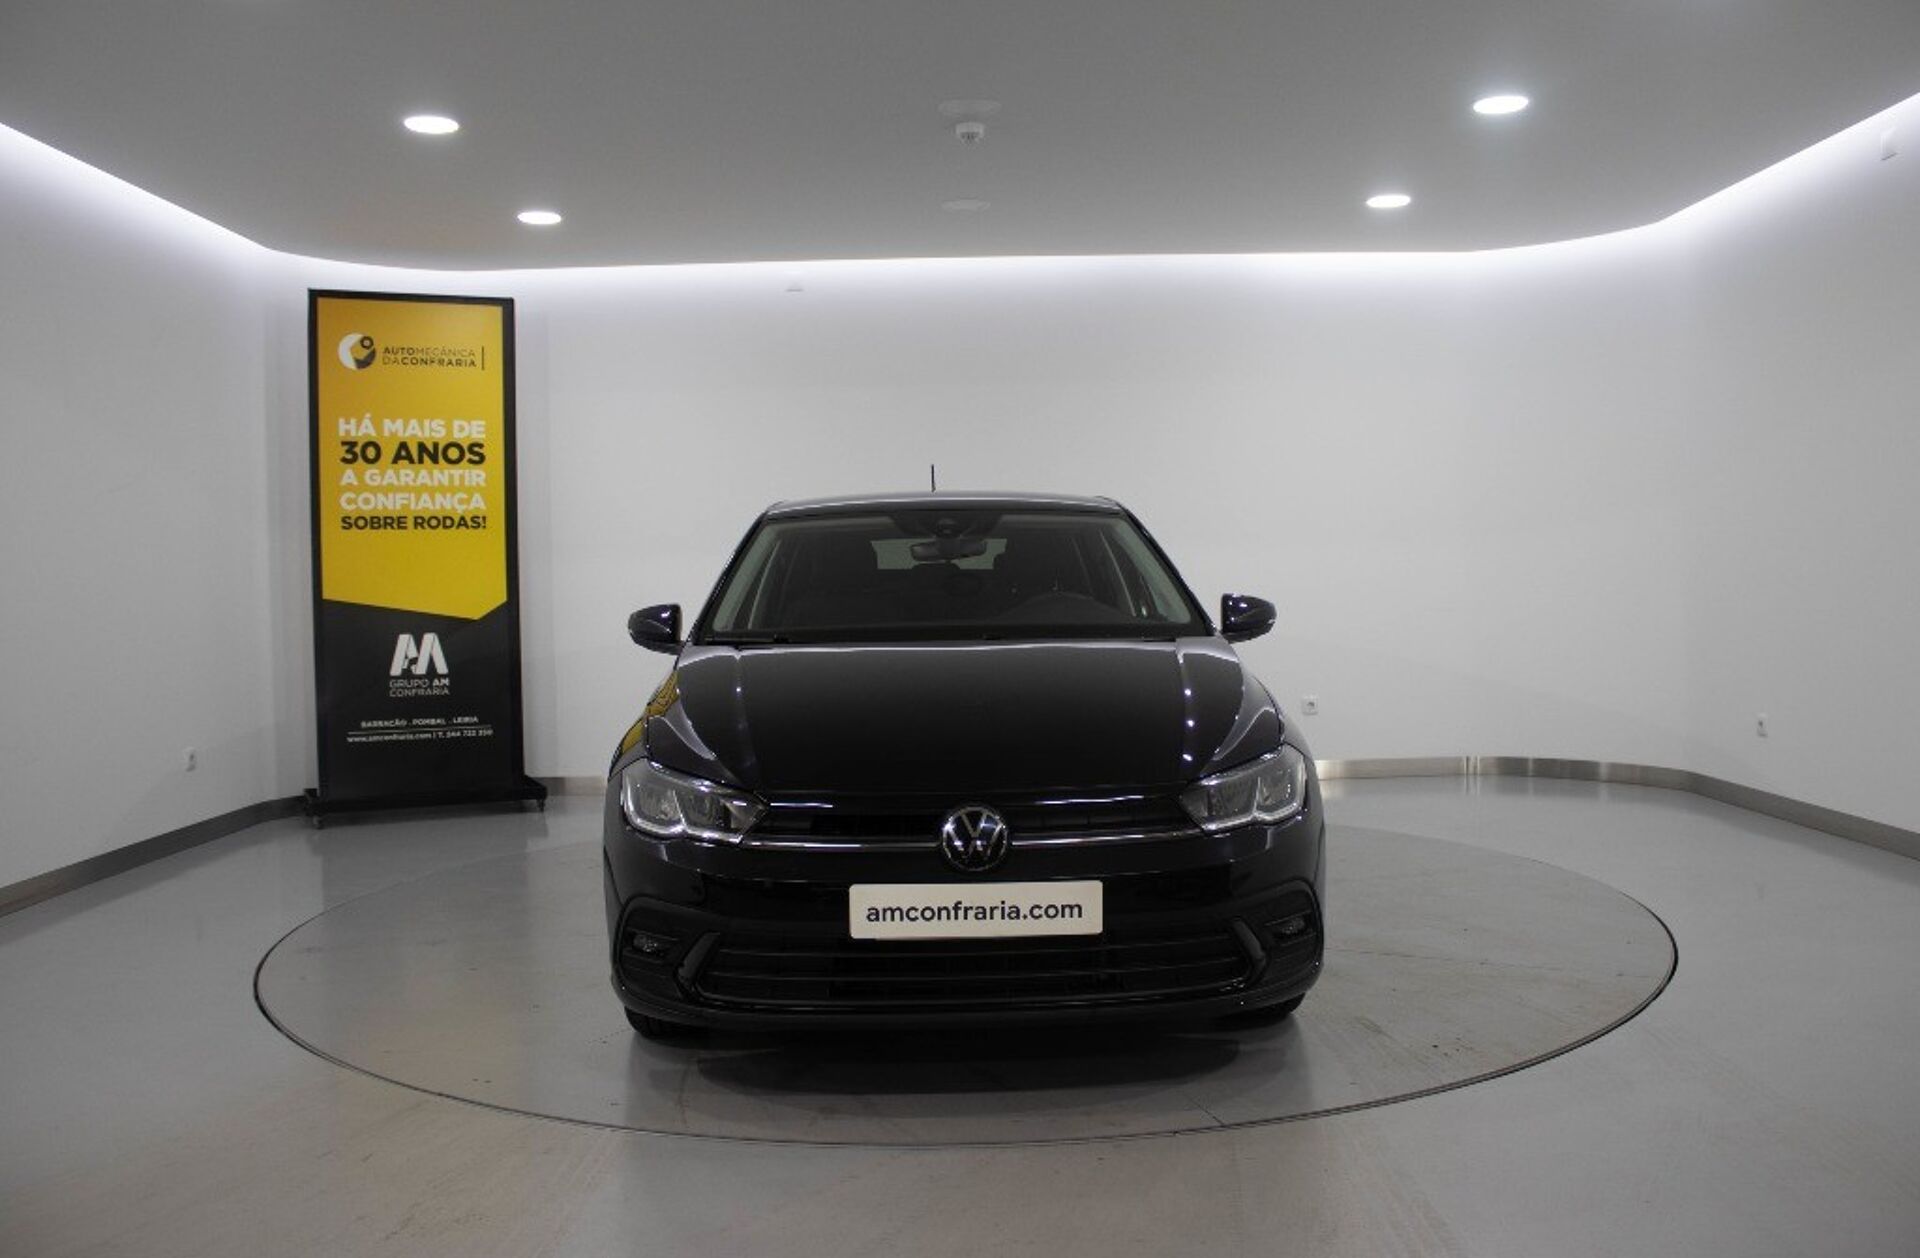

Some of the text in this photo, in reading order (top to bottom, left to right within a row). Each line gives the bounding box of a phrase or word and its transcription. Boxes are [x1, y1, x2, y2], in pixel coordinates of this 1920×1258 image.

[338, 413, 486, 438] HÁ MAIS DE
[340, 441, 486, 465] 30 ANOS
[340, 469, 486, 487] A GARANTIR
[340, 492, 487, 514] CONFIANÇA
[341, 515, 487, 530] SOBRE RODAS!
[389, 678, 450, 688] GRUPO AM
[389, 687, 450, 697] CONFRARIA
[866, 901, 1083, 923] amconfraria.com
